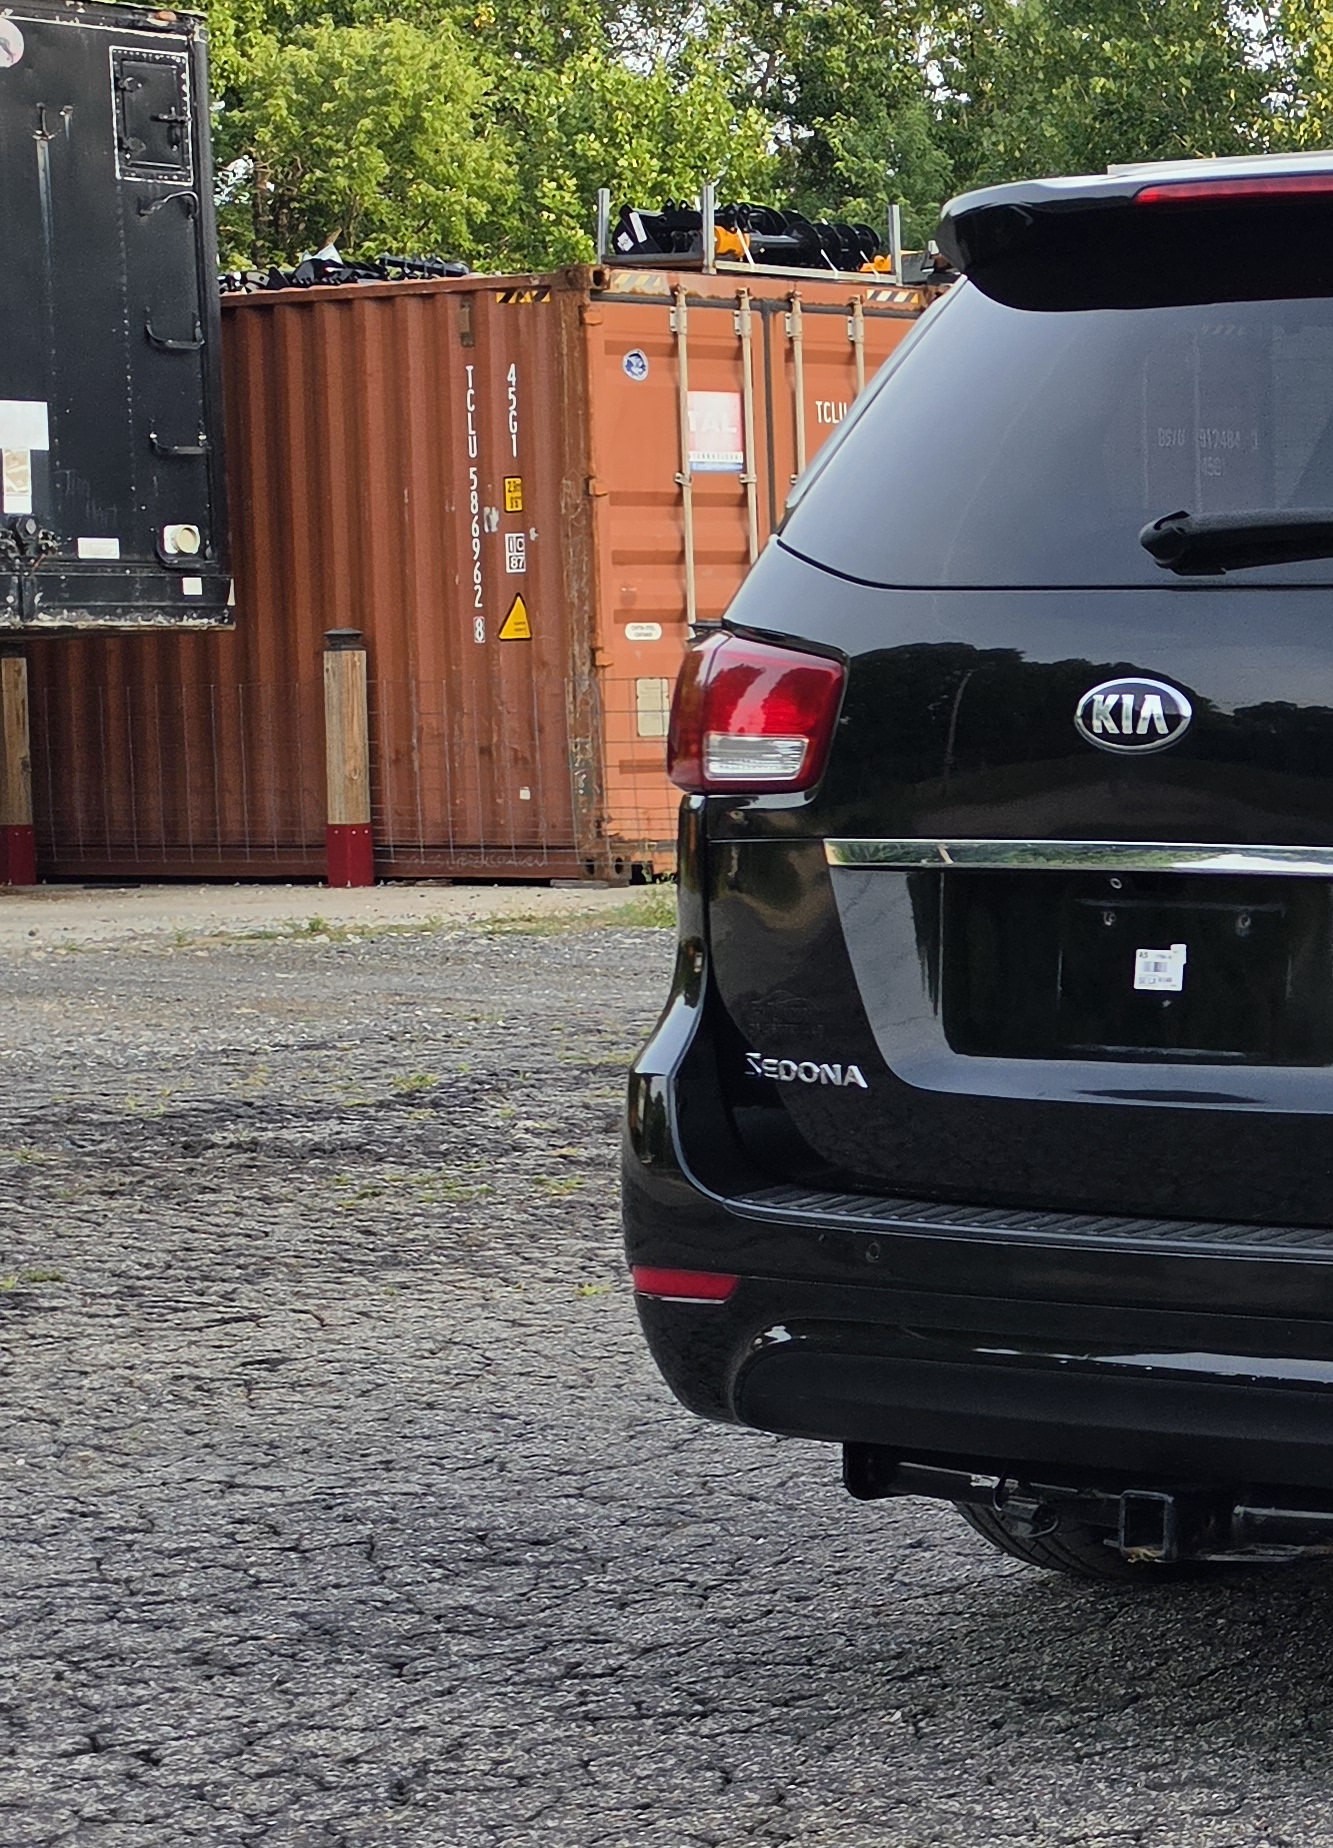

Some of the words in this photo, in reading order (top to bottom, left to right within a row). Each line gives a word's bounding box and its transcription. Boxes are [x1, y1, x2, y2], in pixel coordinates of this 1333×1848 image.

[465, 365, 478, 458] TCLU
[507, 363, 518, 458] 45G1
[687, 411, 737, 434] TAL
[469, 467, 483, 608] 586962
[474, 616, 485, 643] 8
[1092, 694, 1169, 735] KIA
[744, 1052, 868, 1088] SEDONA
